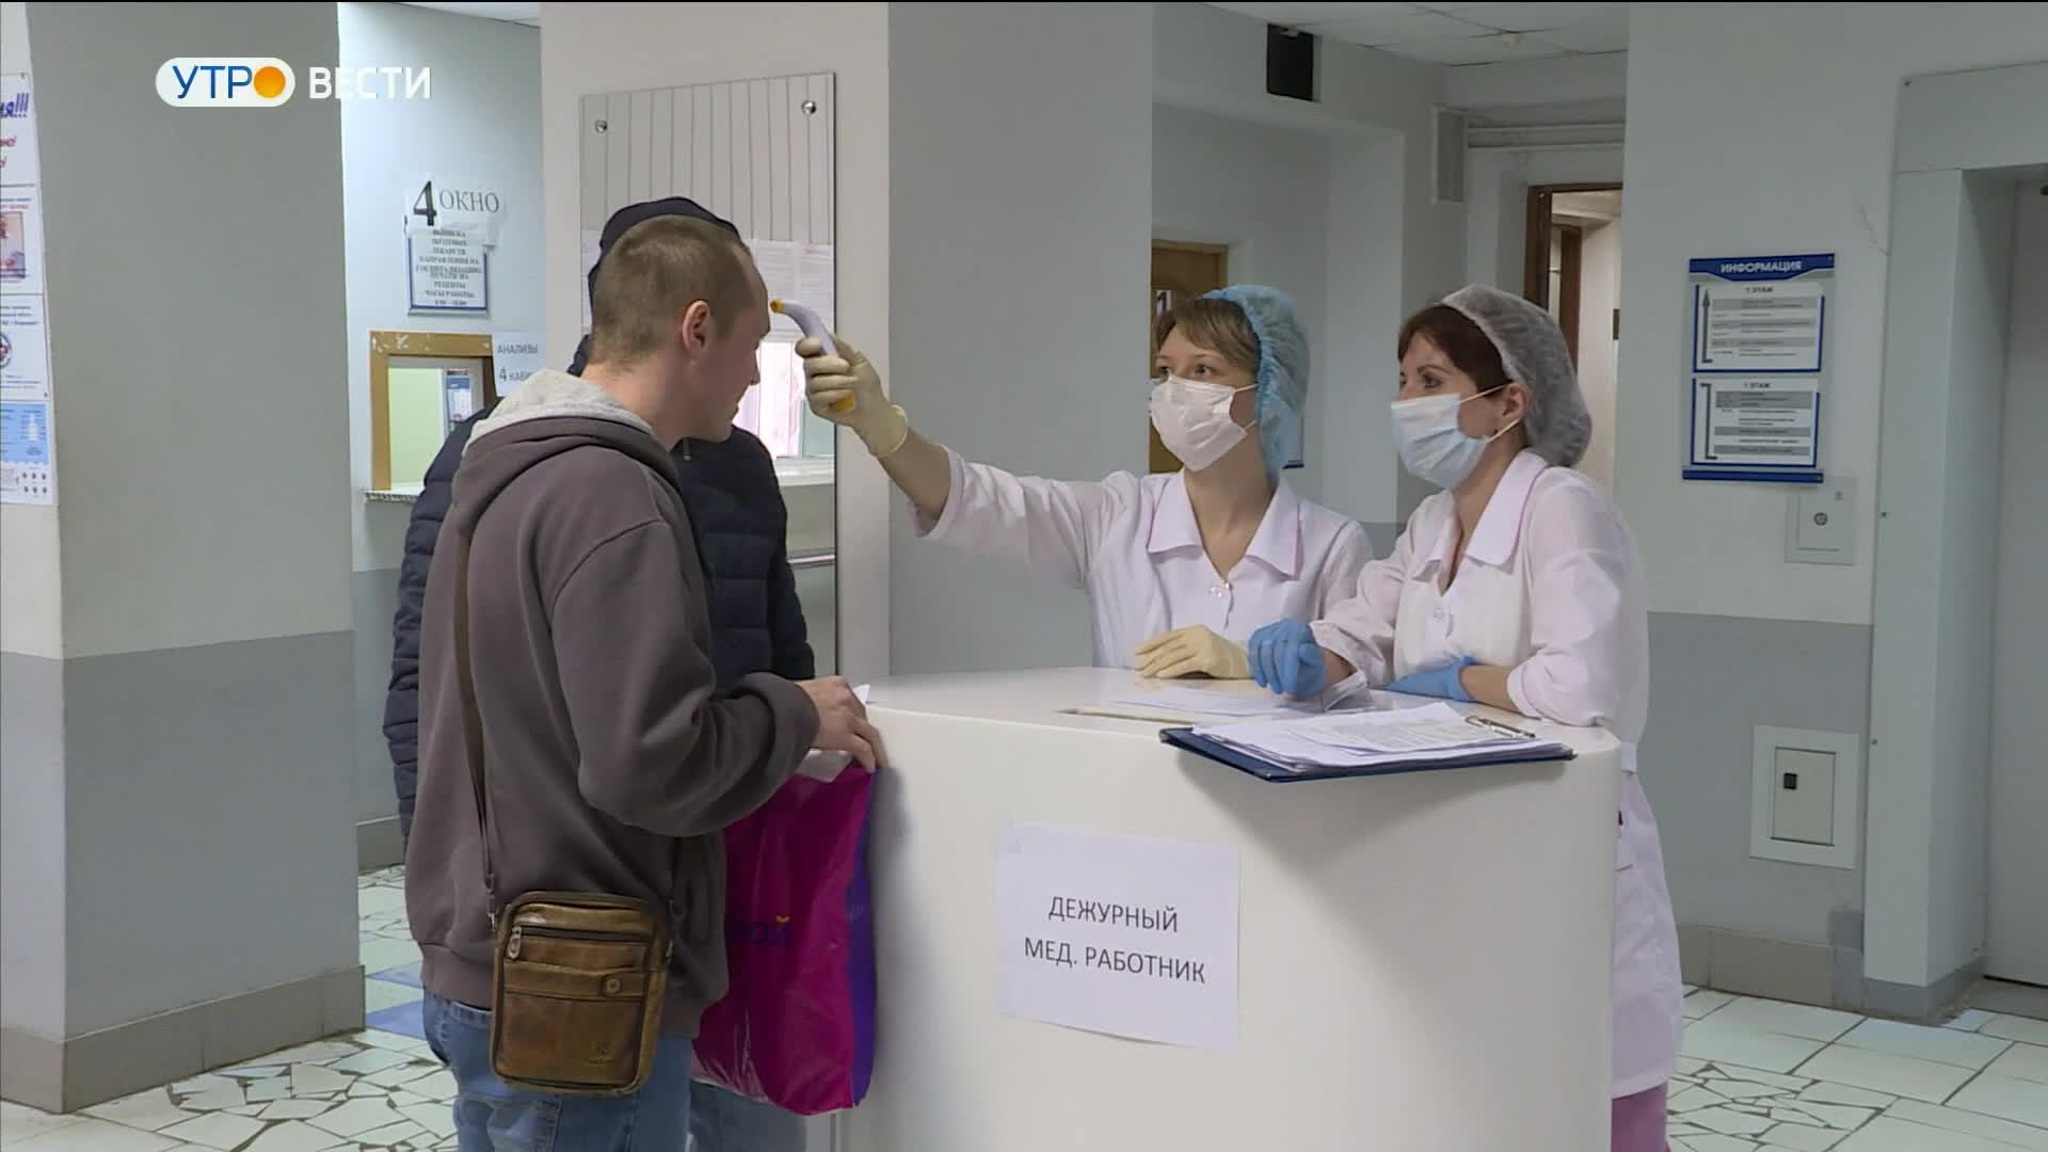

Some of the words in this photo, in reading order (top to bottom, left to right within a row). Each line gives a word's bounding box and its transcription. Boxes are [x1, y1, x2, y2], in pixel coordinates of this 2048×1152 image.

[413, 180, 437, 226] 4
[439, 188, 500, 214] ОКНО
[1720, 261, 1802, 273] ИНФОРМАЦИЯ
[497, 344, 538, 354] АНАЛИЗЫ
[498, 367, 507, 381] 4
[1048, 896, 1178, 933] ДЕЖУРНЫЙ
[1024, 937, 1078, 968] МЕД.
[1085, 946, 1206, 984] РАБОТНИК
